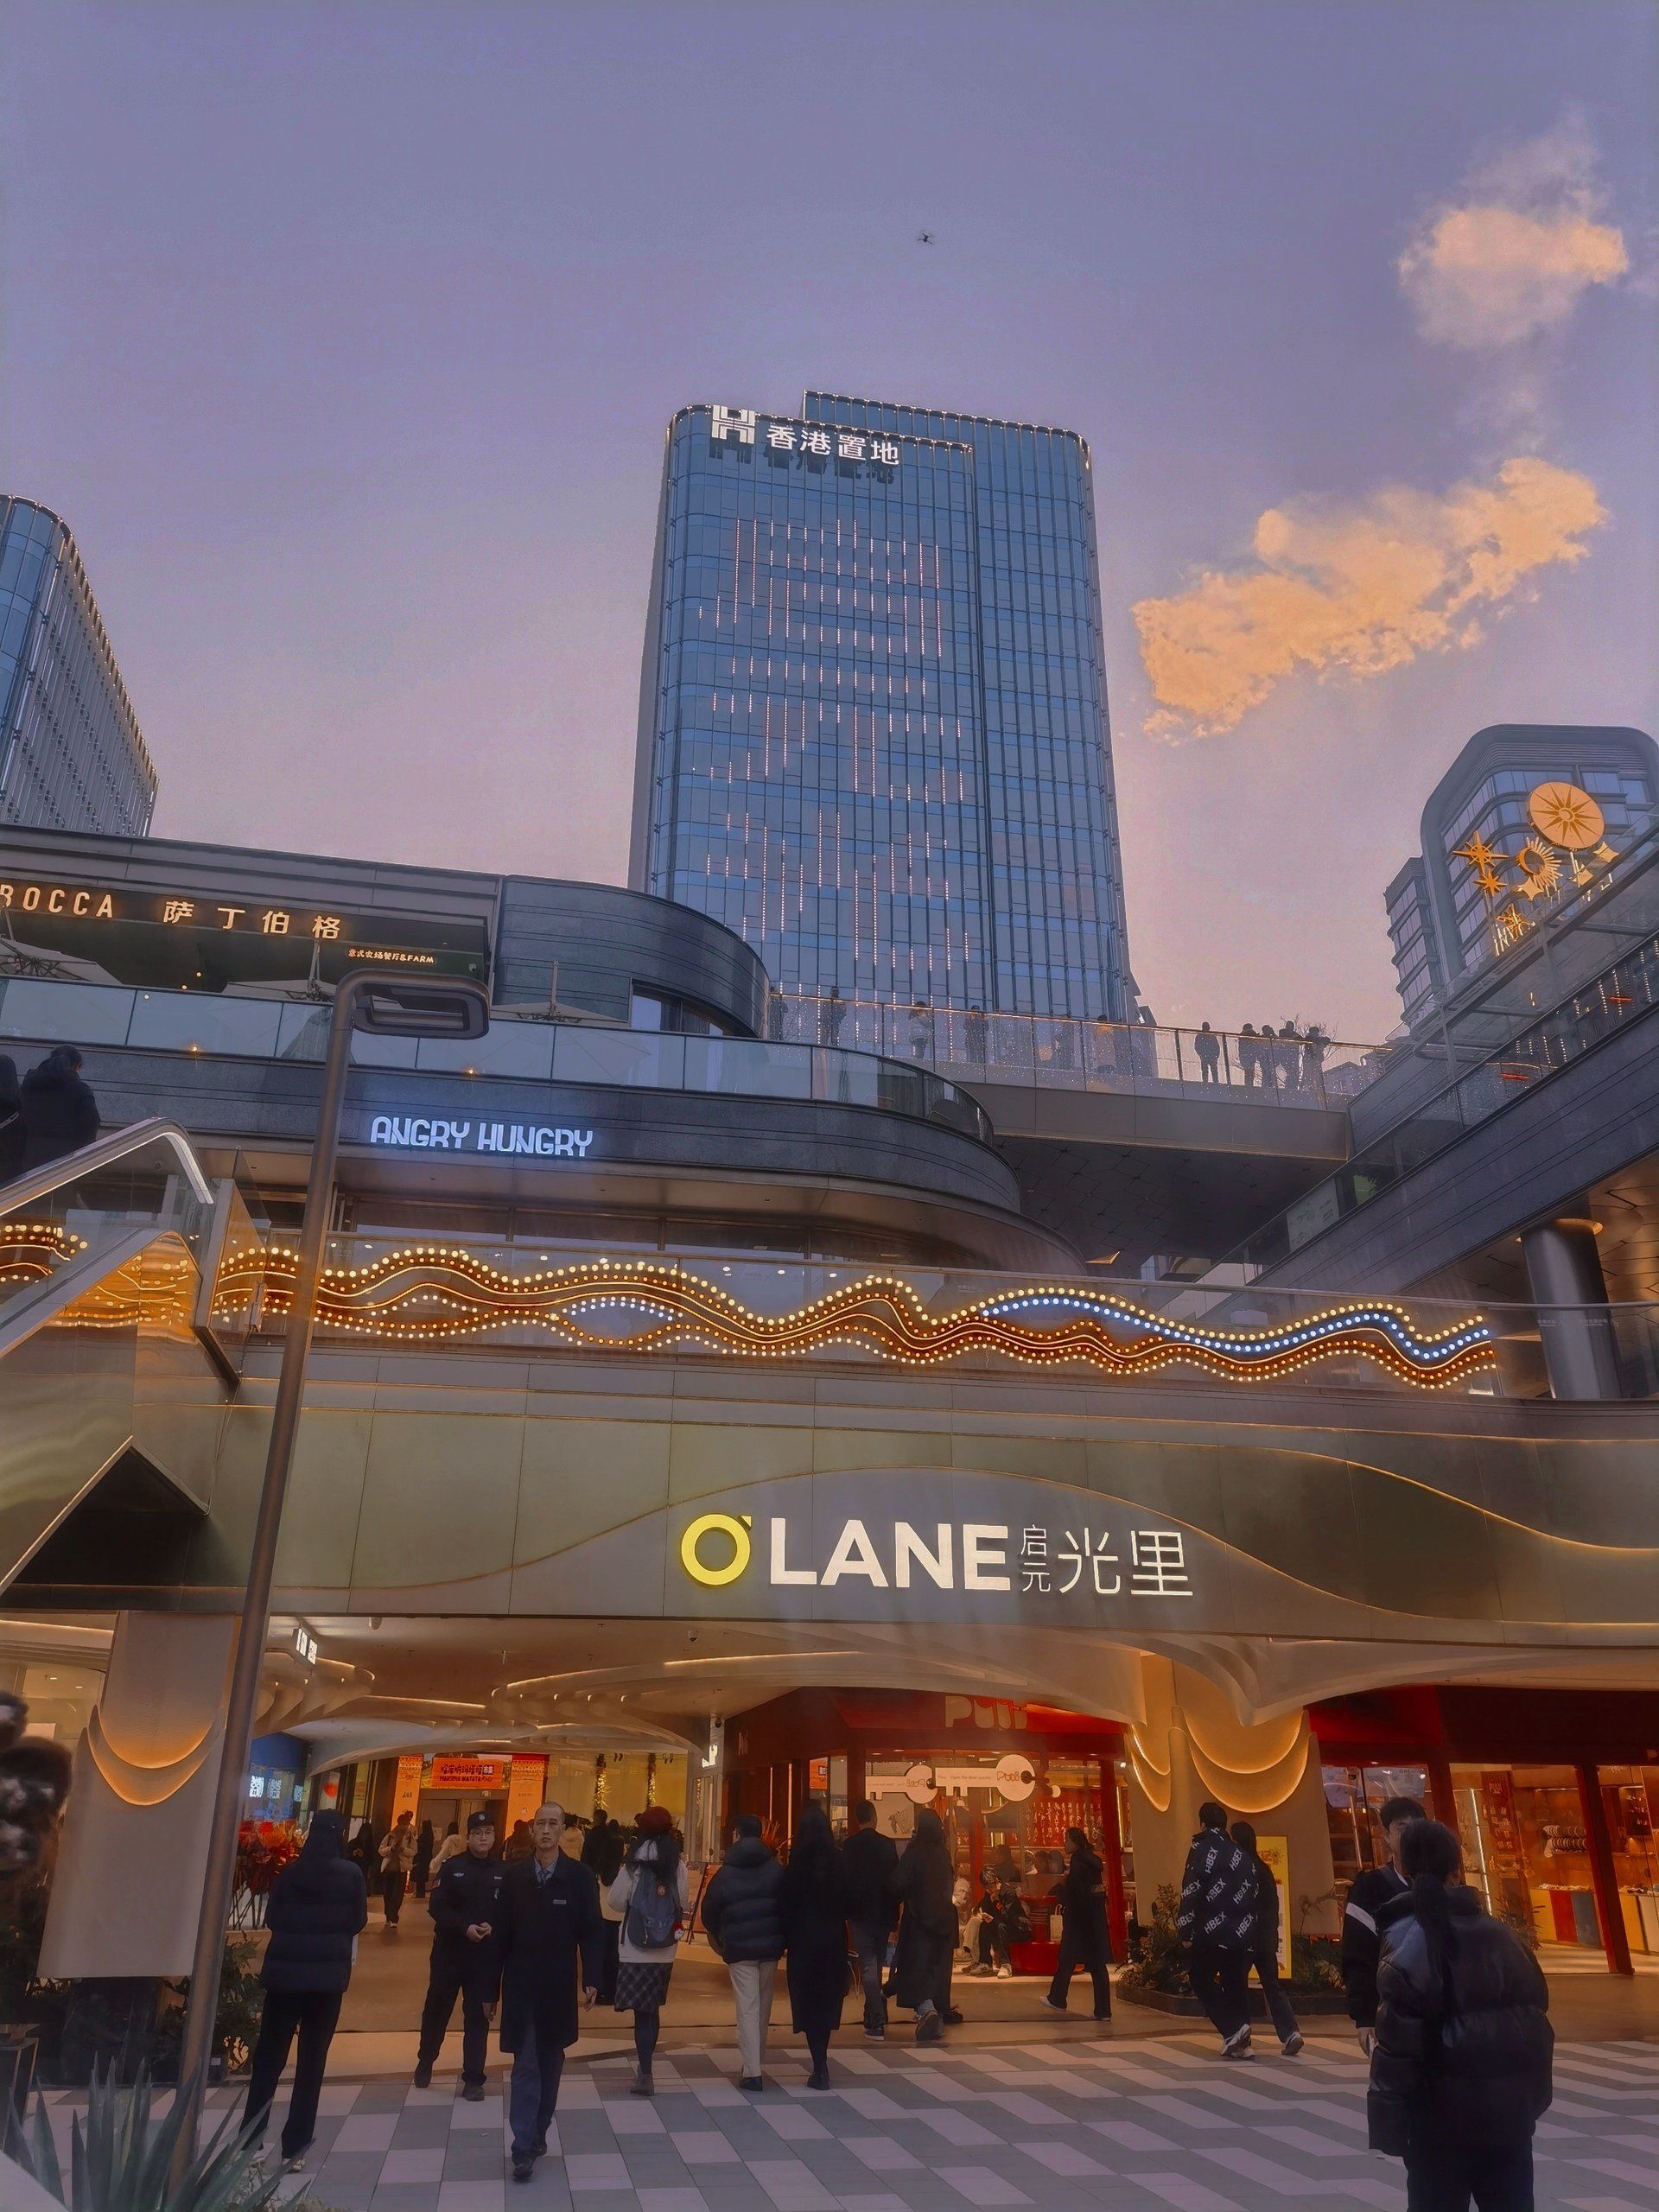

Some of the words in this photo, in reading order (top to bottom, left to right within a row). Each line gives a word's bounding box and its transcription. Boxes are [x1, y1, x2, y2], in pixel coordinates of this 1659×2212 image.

[766, 424, 899, 465] 香港置地
[163, 900, 340, 939] 萨丁伯格
[371, 1116, 471, 1148] ANGRY
[477, 1122, 593, 1157] HUNGRY
[1058, 1528, 1193, 1597] 光里
[1205, 1847, 1219, 1874] HBEX
[1205, 1878, 1227, 1903] HBEX
[1232, 1878, 1252, 1904] HBEX
[1204, 1910, 1227, 1935] HBEX
[1235, 1912, 1255, 1939] HBEX
